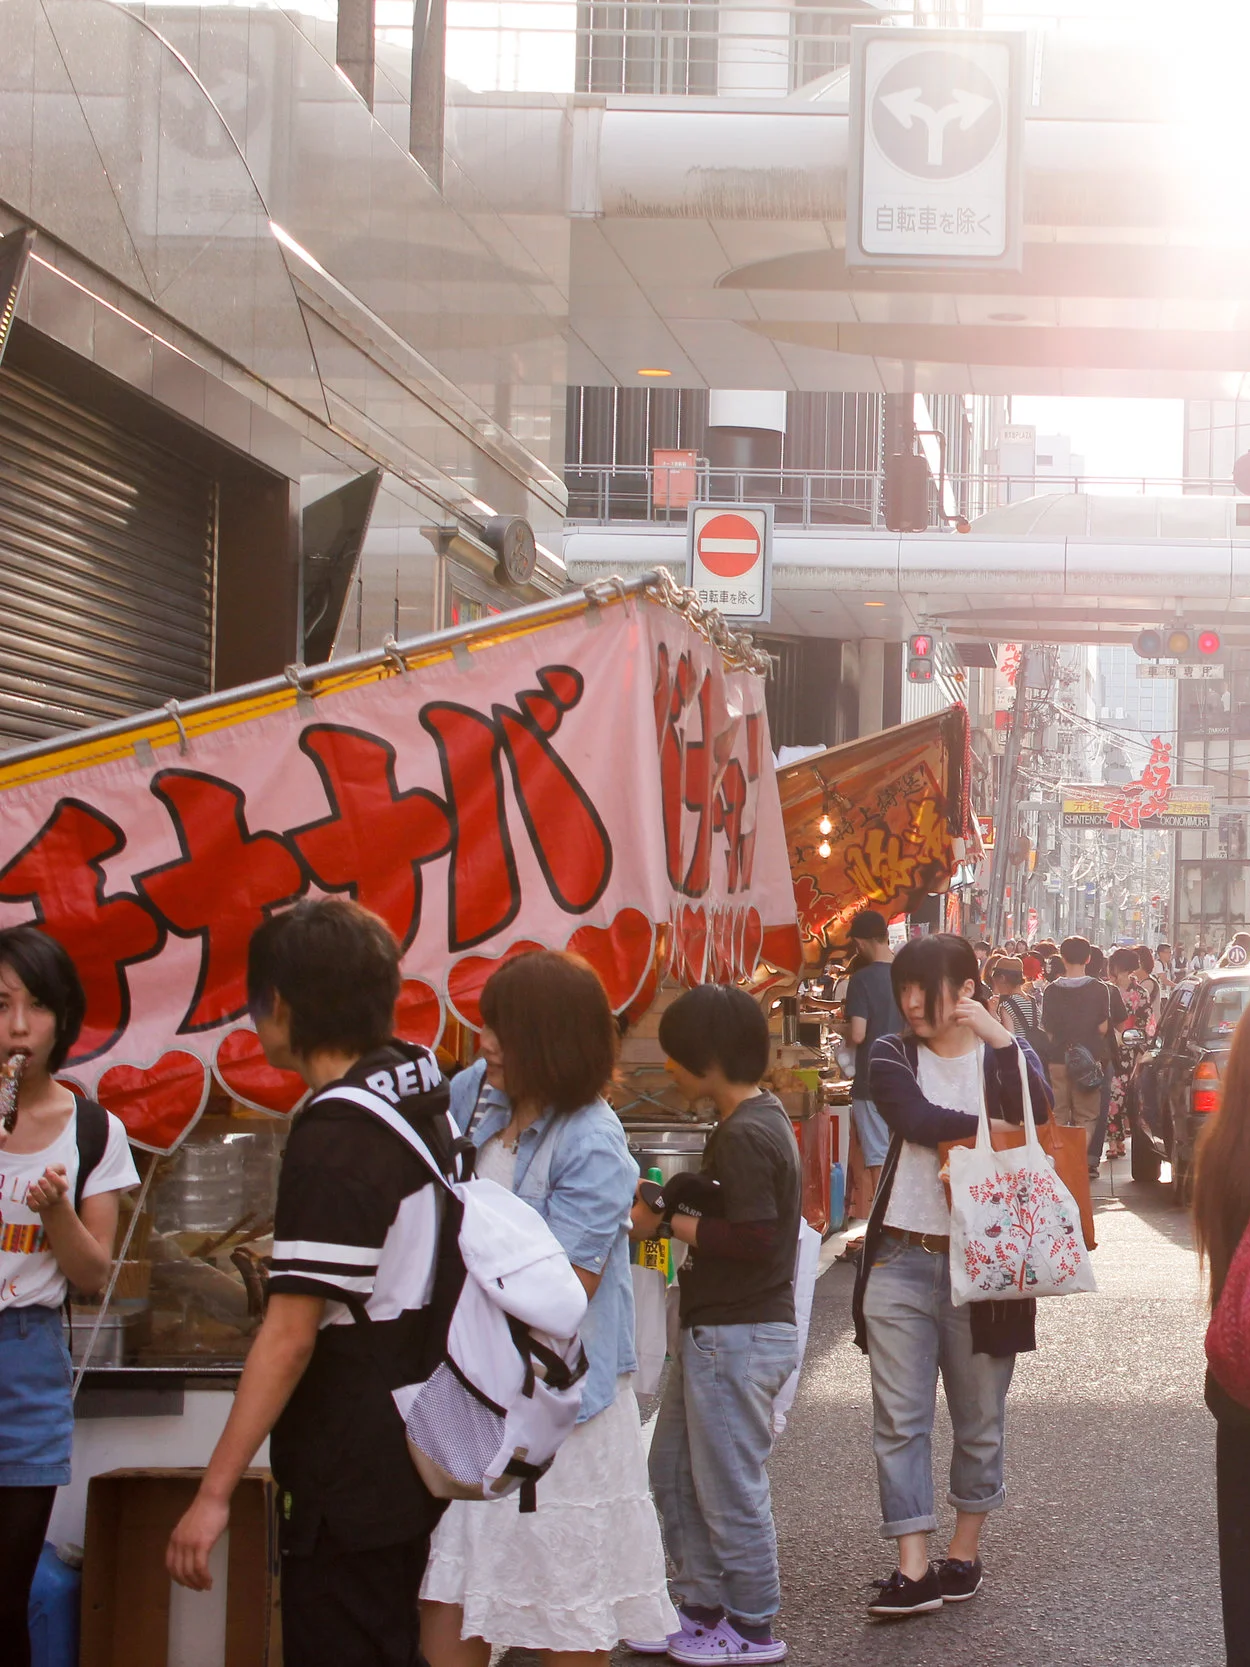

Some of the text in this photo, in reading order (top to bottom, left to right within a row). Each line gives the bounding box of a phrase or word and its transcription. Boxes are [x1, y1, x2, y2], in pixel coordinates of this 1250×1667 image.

[875, 204, 992, 236] 自転車を除く
[699, 590, 756, 605] 自転車を除く
[1148, 665, 1213, 678] 車両専用
